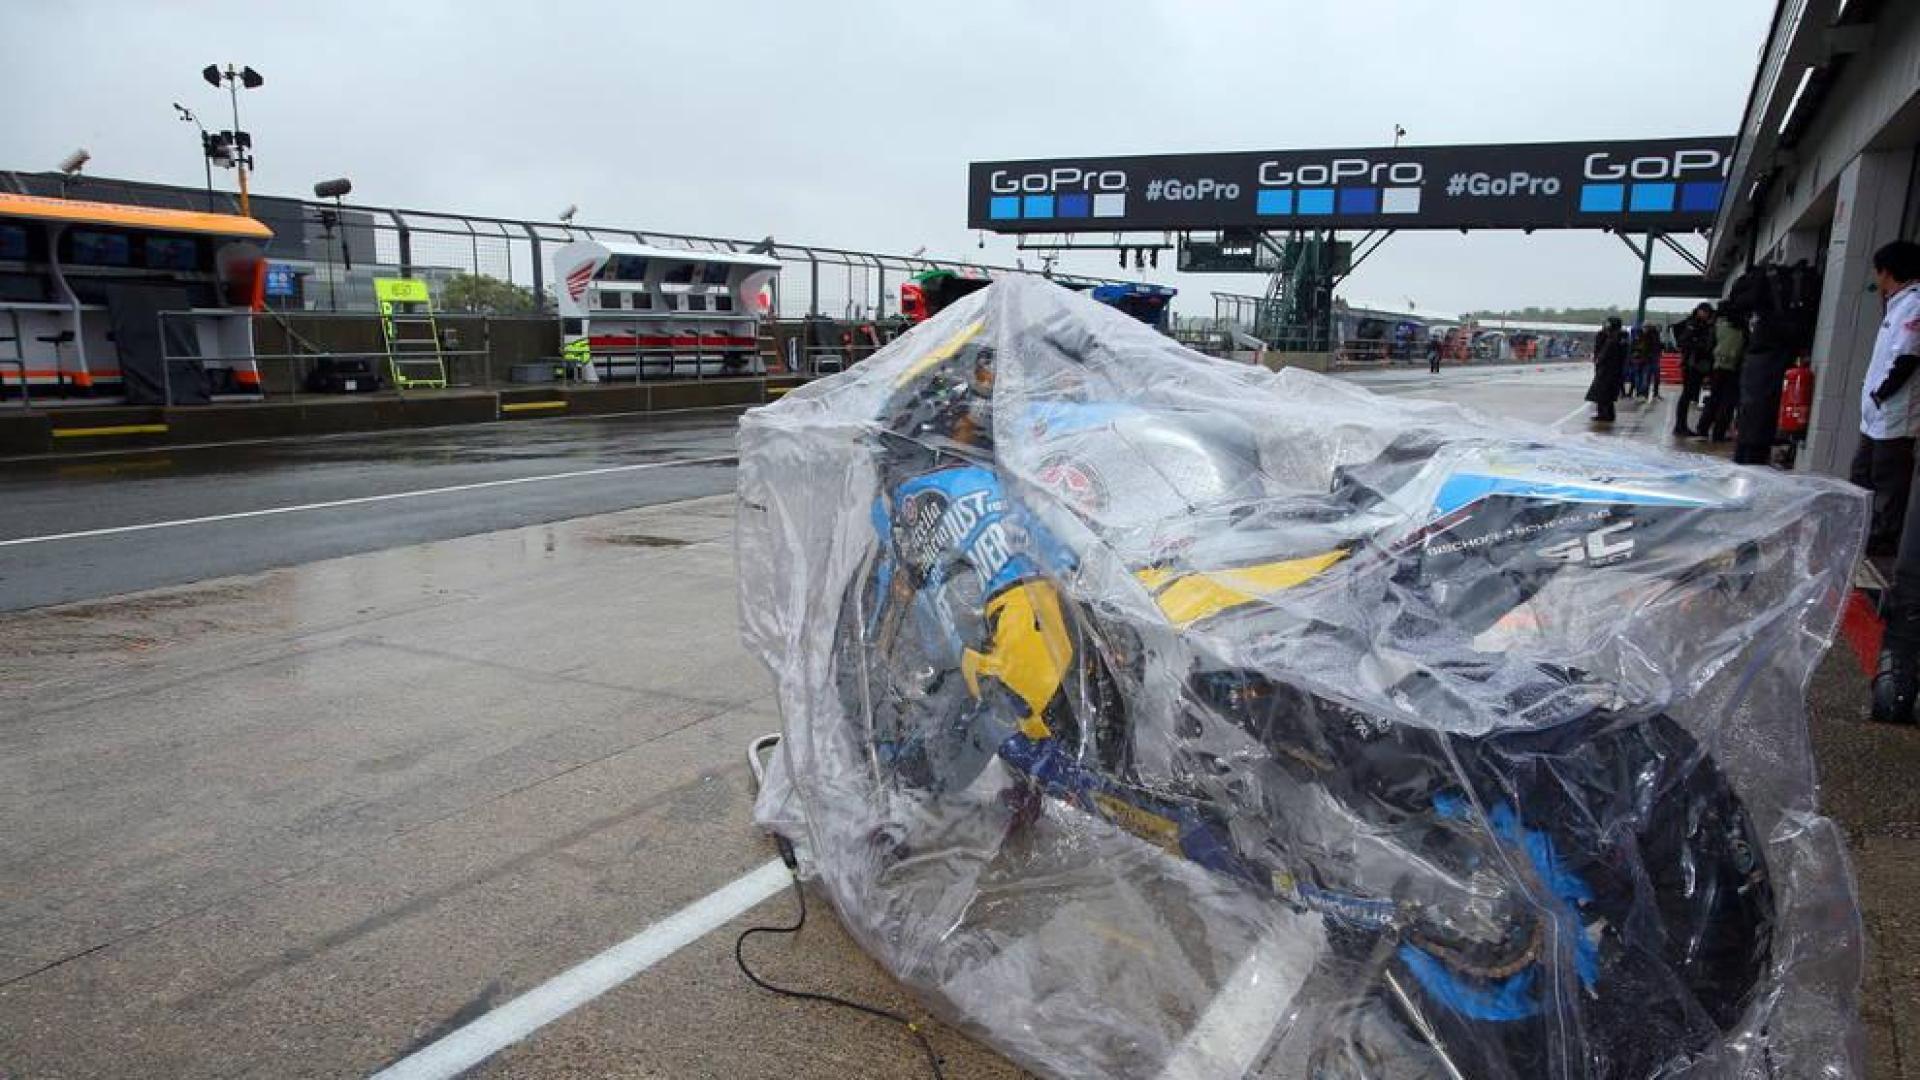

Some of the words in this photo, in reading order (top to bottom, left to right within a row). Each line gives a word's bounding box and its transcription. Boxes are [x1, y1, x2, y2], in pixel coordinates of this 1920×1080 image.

[1258, 157, 1427, 186] GoPro
[1583, 150, 1733, 180] GoPr
[990, 167, 1129, 193] GoPro
[1146, 177, 1240, 201] #GoPro
[1446, 171, 1560, 197] #GoPro
